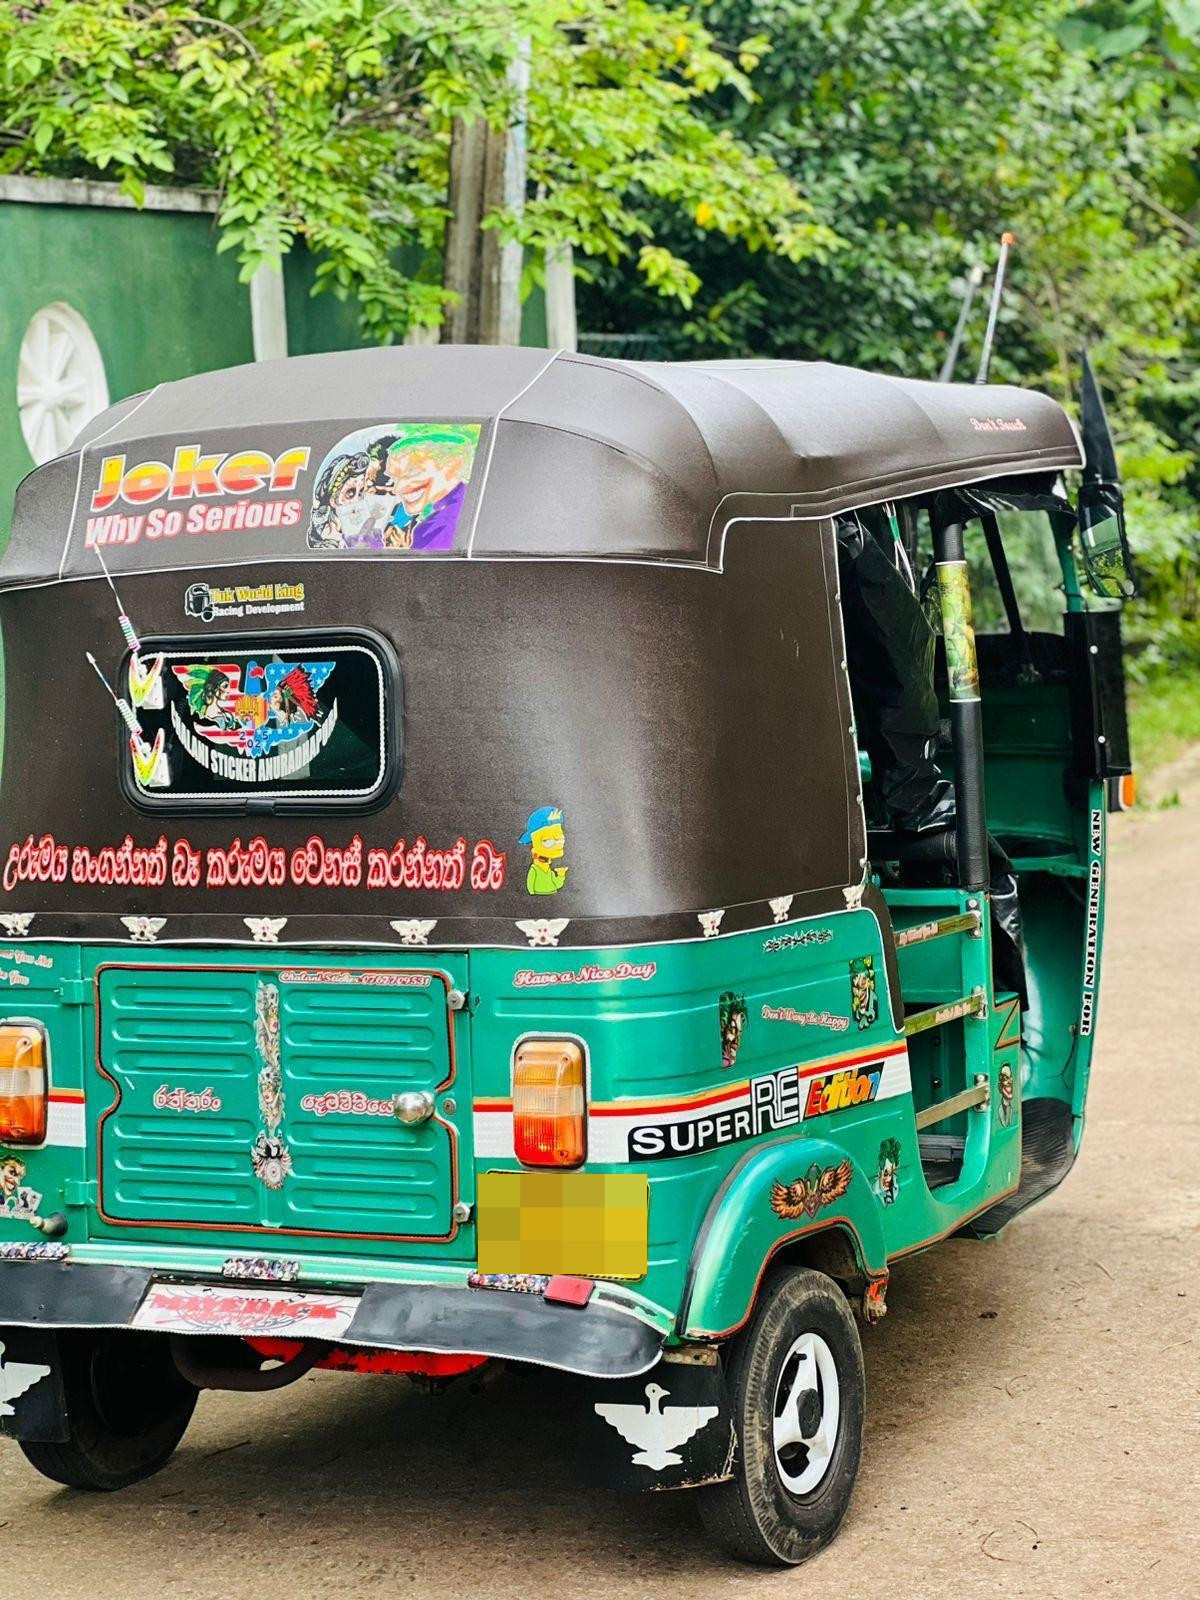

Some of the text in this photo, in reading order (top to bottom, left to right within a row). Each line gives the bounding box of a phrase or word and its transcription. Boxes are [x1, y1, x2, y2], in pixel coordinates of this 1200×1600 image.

[90, 444, 311, 513] Joker
[84, 498, 301, 548] Why So Serious
[211, 601, 305, 617] Racing Development
[235, 584, 274, 602] World
[210, 749, 257, 783] STICKER
[1091, 809, 1101, 855] NEW
[71, 834, 167, 888] හංගන්නත්
[172, 839, 201, 887] බෑ
[290, 834, 364, 888] වෙනස්
[367, 835, 467, 890] කරන්නත්
[470, 839, 506, 892] බෑ
[1085, 861, 1101, 988] GENERATION
[513, 962, 656, 988] Have a Nice Day
[818, 1012, 849, 1031] Happy
[632, 1067, 799, 1155] SUPER RE
[803, 1070, 882, 1118] Edition
